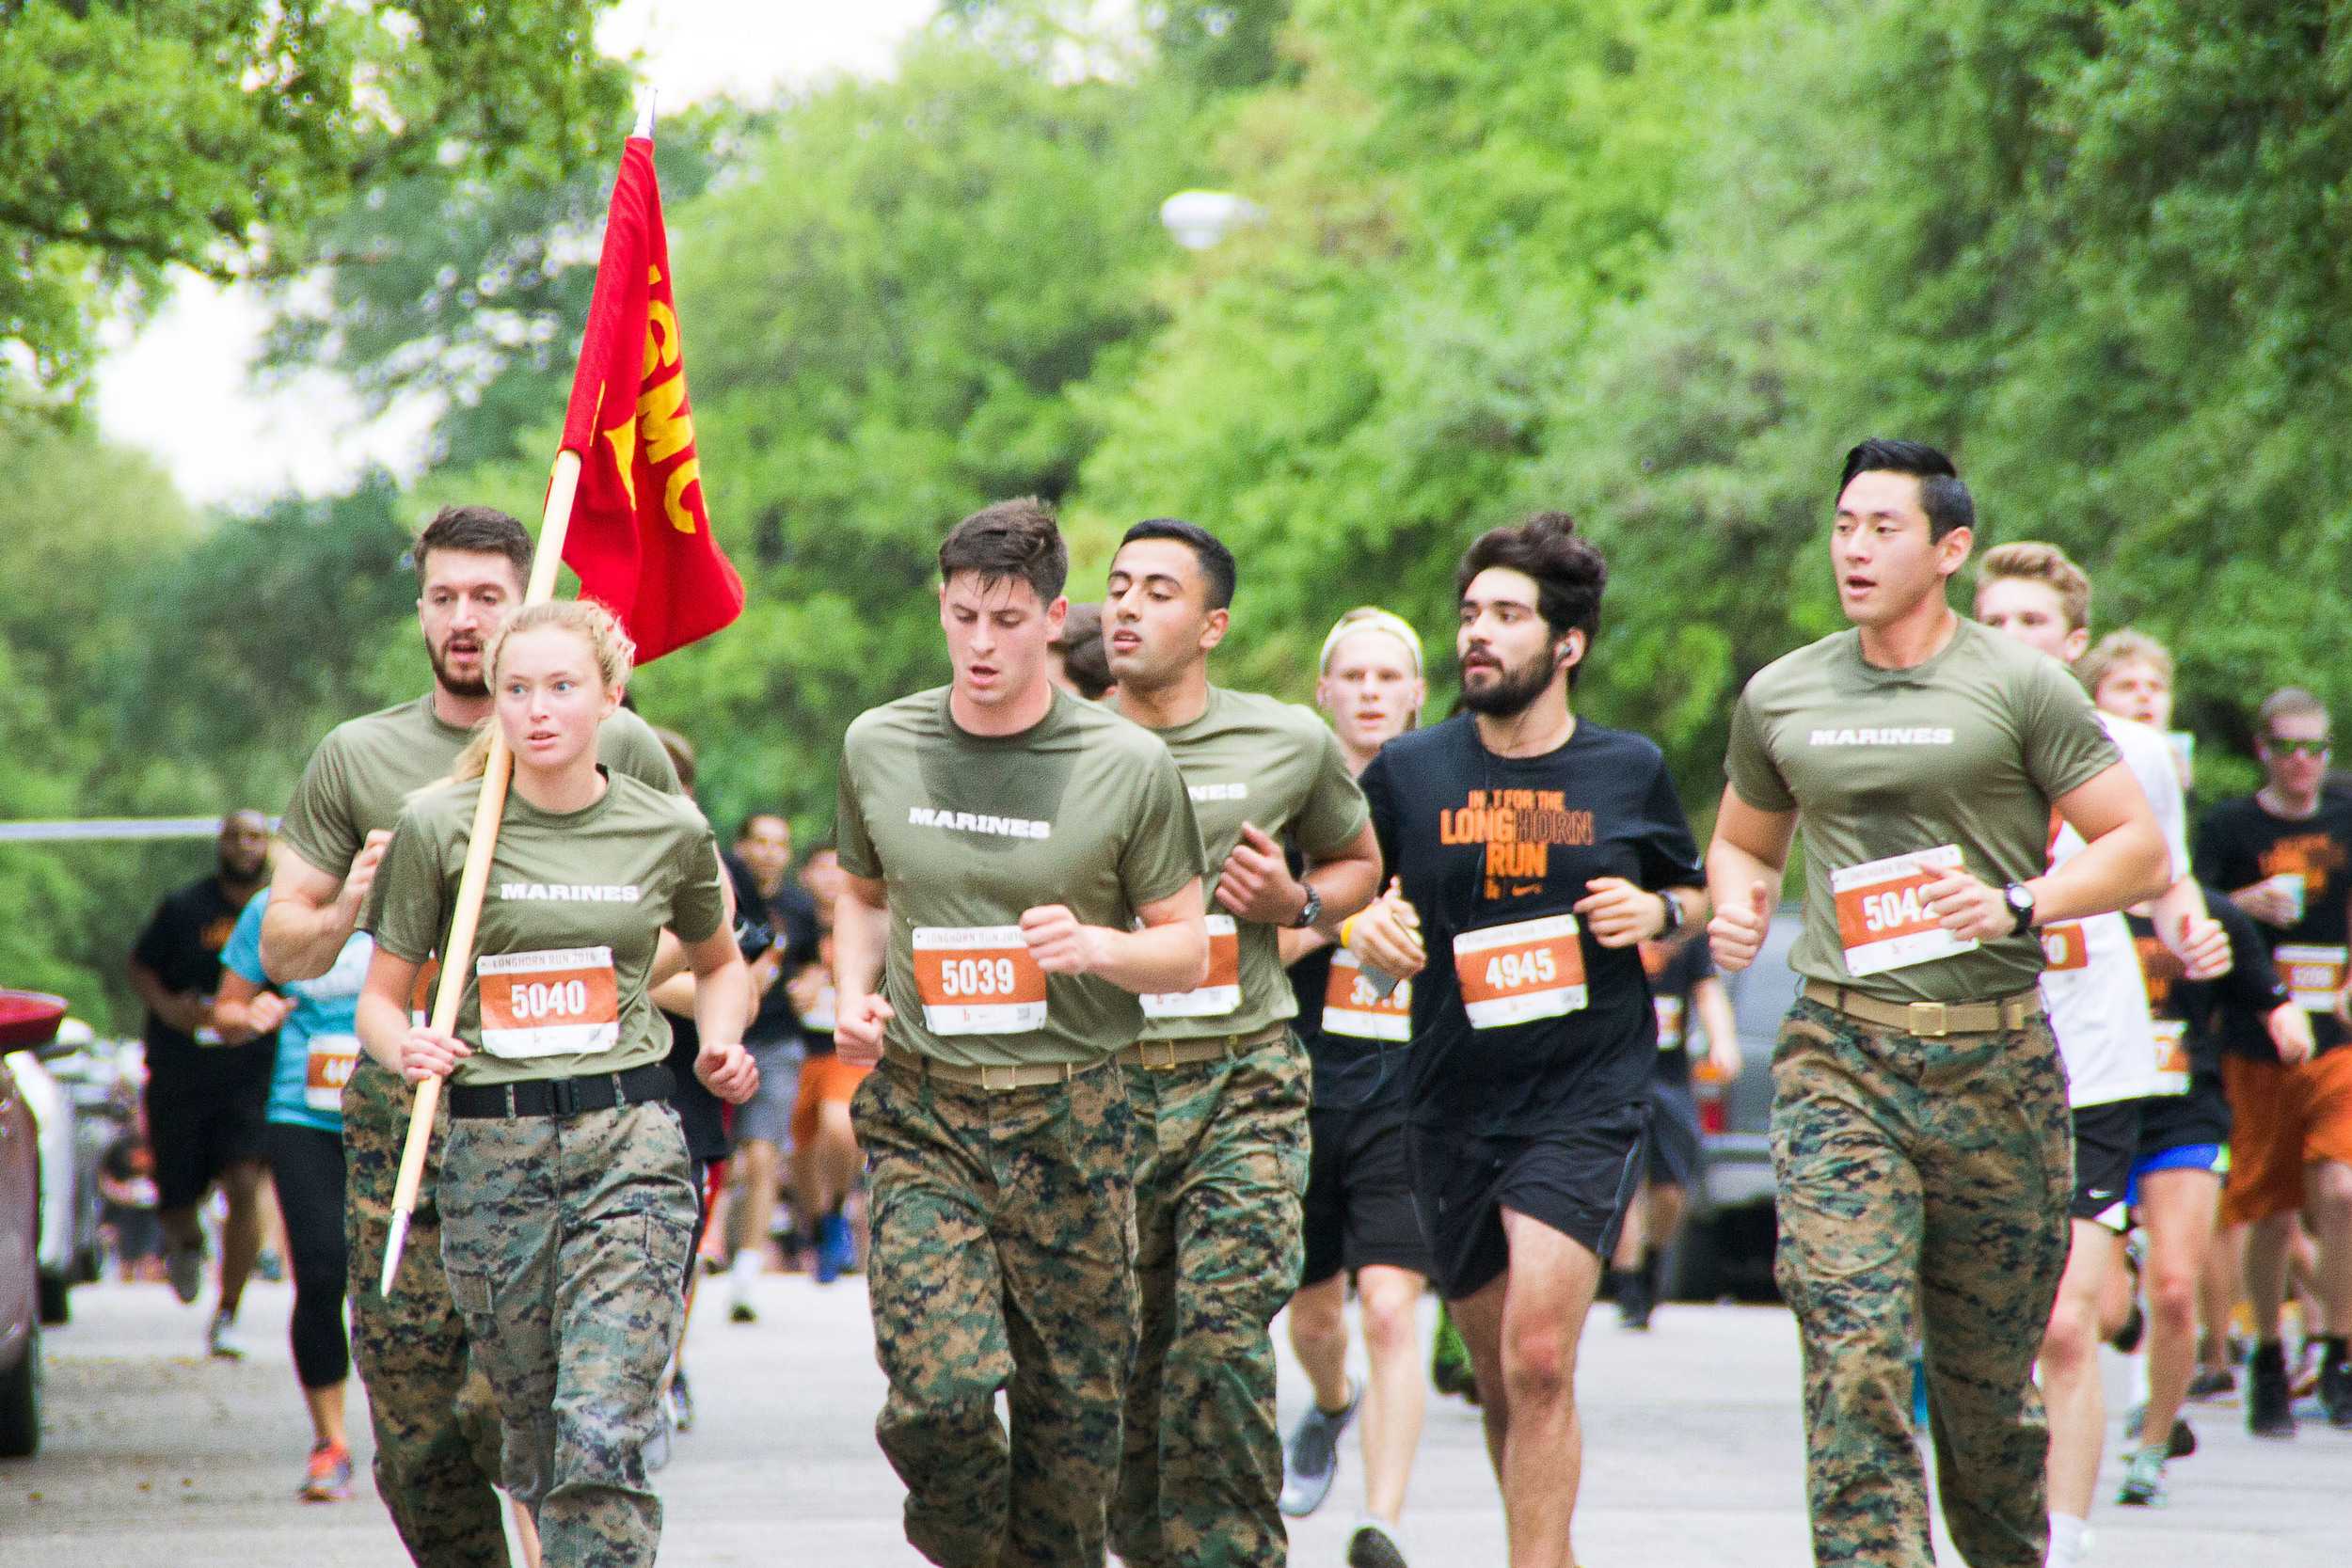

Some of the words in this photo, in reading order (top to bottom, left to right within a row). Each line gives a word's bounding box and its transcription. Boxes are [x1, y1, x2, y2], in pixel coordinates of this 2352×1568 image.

[1809, 728, 1955, 746] MARINES
[909, 807, 1051, 839] MARINES
[1439, 807, 1595, 847] LONGHORN
[1486, 842, 1549, 879] RUN
[501, 882, 640, 903] MARINES
[941, 958, 1016, 997] 5039
[1485, 947, 1557, 991] 4945
[511, 979, 586, 1020] 5040
